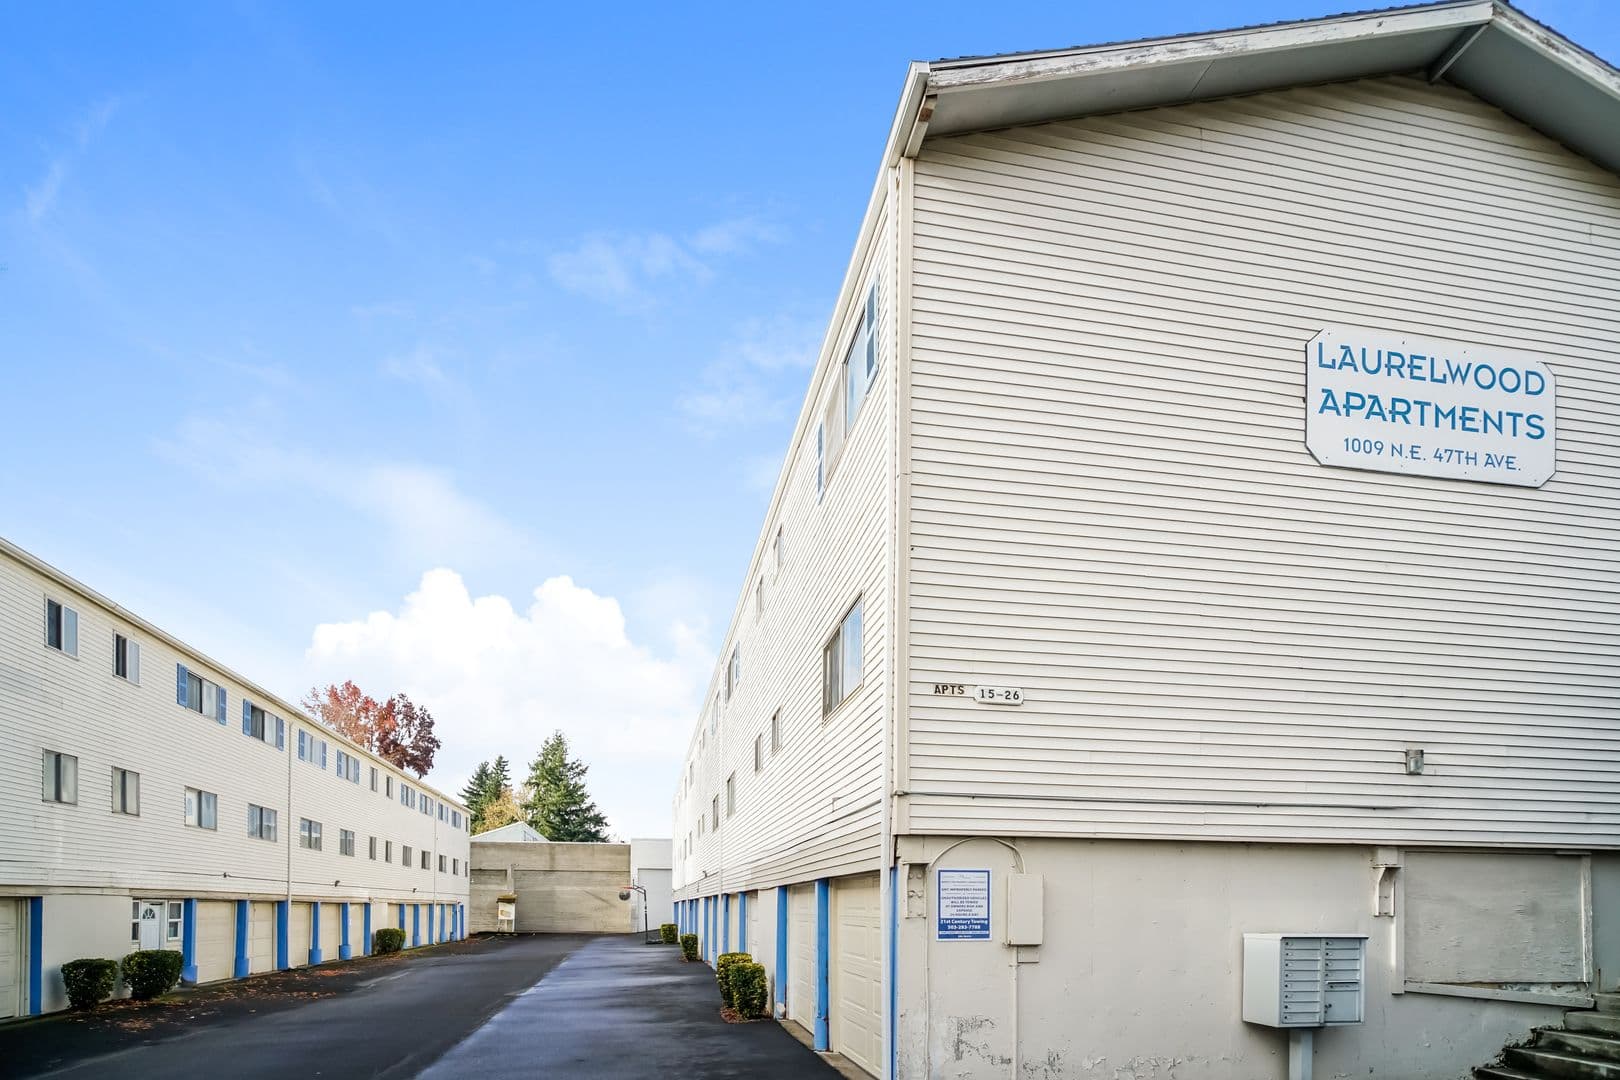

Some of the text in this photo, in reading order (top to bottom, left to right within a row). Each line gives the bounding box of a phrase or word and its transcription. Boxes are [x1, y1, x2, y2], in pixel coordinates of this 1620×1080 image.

[1318, 341, 1546, 396] LAURELWOOD
[1318, 388, 1546, 440] APARTMENTS
[1343, 436, 1522, 472] 1009 N.E. 47TH AVE.
[934, 684, 1020, 700] APTS 15-26
